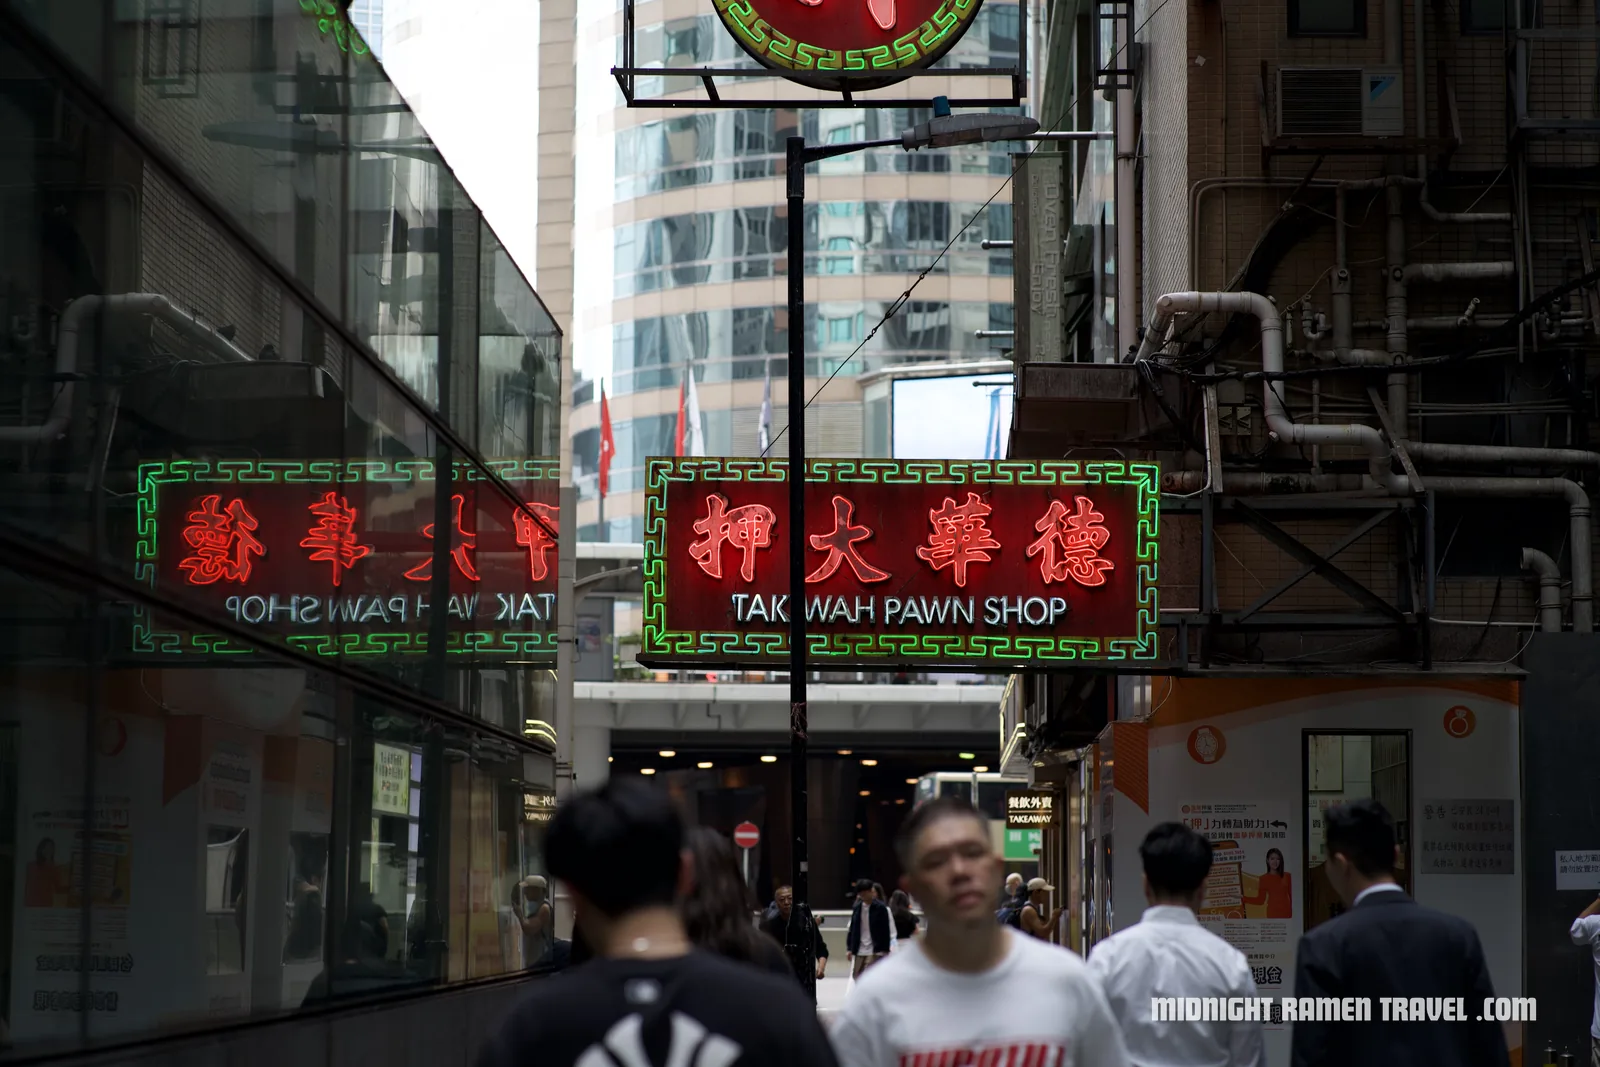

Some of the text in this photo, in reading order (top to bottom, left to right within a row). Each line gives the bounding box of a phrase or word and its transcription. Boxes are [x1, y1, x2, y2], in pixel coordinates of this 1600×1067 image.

[1030, 262, 1045, 317] Enjoy
[1044, 249, 1061, 319] Fresh
[731, 593, 1068, 627] TAK WAH PAWN SHOP
[1008, 815, 1053, 824] TAKEAWAY
[1560, 854, 1600, 863] 私人地方範
[1560, 865, 1600, 874] 請勿放置垃
